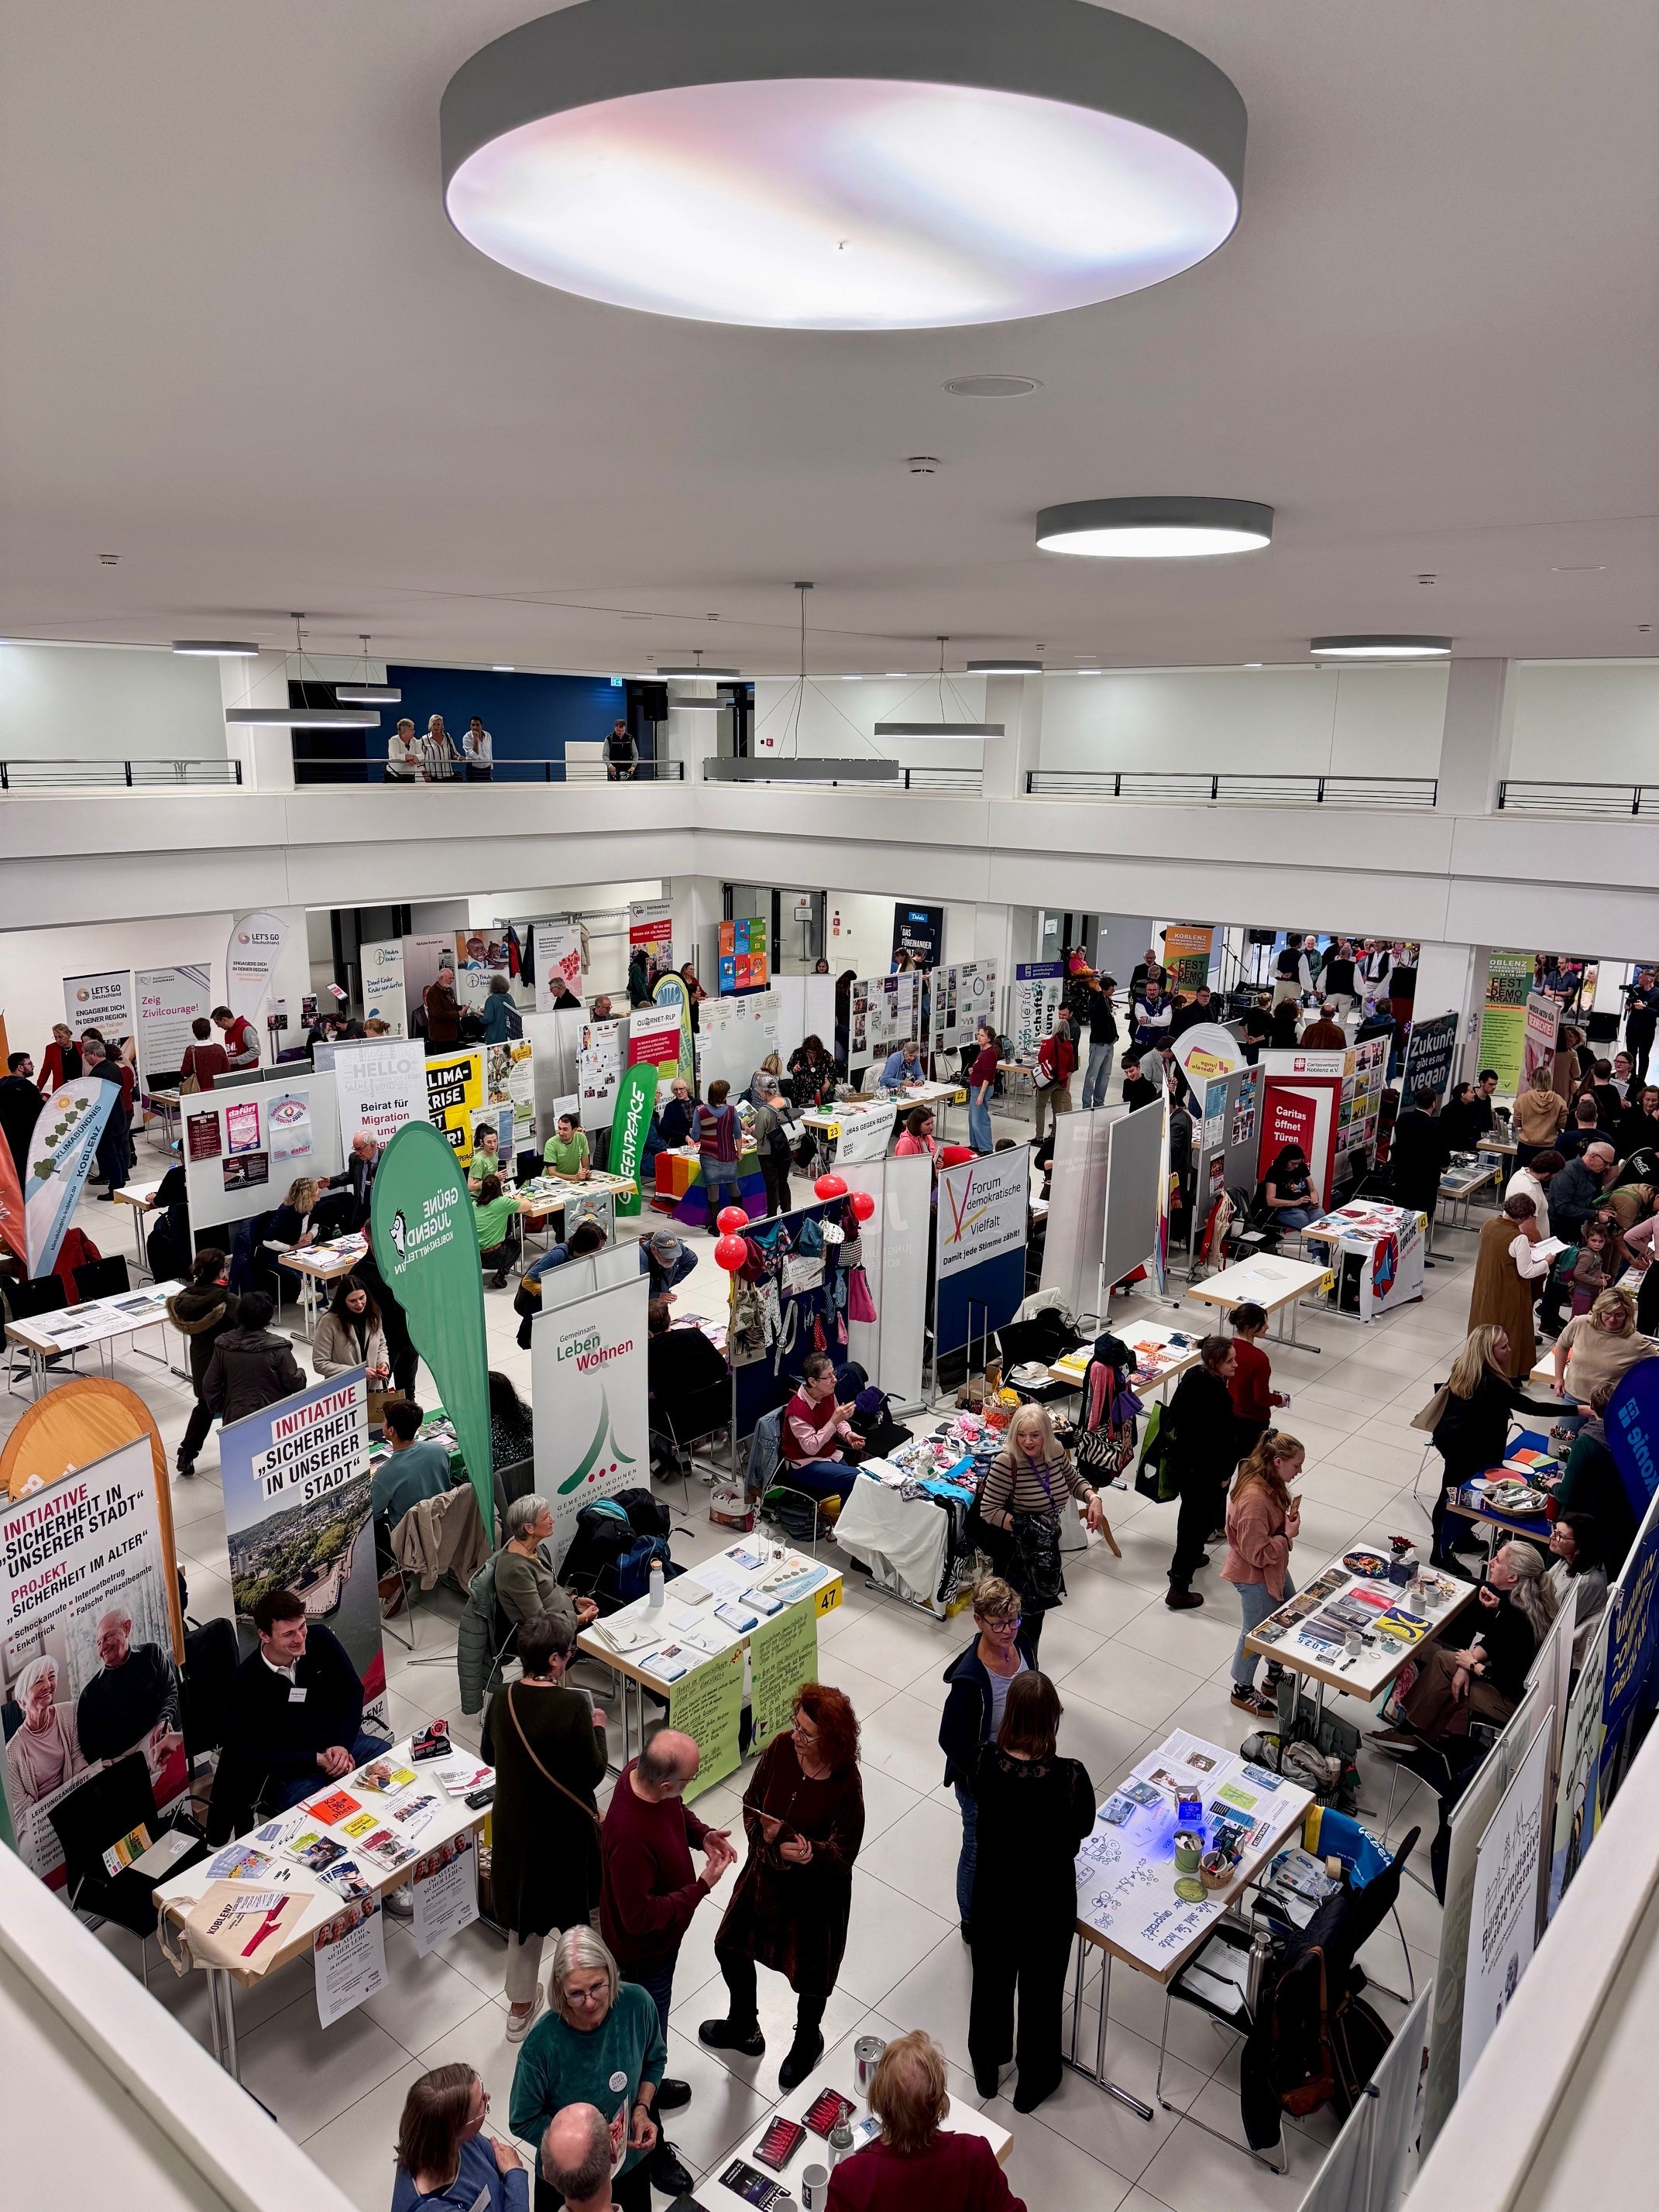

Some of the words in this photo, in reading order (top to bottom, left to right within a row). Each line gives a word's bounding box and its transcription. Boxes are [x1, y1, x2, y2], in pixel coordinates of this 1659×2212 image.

[902, 928, 911, 937] DAS
[902, 937, 932, 950] FÜREINANDER
[1179, 959, 1205, 970] FEST
[1489, 959, 1527, 967] OBLENZ
[1179, 970, 1204, 980] DEMO
[1492, 977, 1523, 988] FEST
[91, 985, 110, 994] LET'S
[92, 991, 122, 1000] Deutschland
[1491, 988, 1523, 998] DEMO
[141, 996, 161, 1005] Zeig
[1529, 1004, 1539, 1013] WERDE
[76, 1006, 110, 1017] ENGAGIERE
[110, 1004, 125, 1014] DICH
[83, 1016, 105, 1025] DEINER
[105, 1012, 127, 1022] REGION
[143, 1004, 198, 1018] Zivilcourage!
[1033, 984, 1042, 1038] schafts-
[1410, 1027, 1455, 1057] Zukunft
[353, 1060, 410, 1079] HELLO
[1417, 1058, 1428, 1071] gibt
[1428, 1056, 1435, 1064] es
[1435, 1053, 1445, 1063] nur
[427, 1067, 469, 1089] LIMA-
[1410, 1066, 1446, 1091] vegan
[228, 1105, 256, 1117] dafür!
[271, 1100, 307, 1117] Interkulturelle
[361, 1101, 392, 1112] Beirat
[394, 1099, 409, 1108] für
[1276, 1106, 1307, 1120] Caritas
[292, 1112, 304, 1121] 2025
[362, 1111, 410, 1125] Migration
[846, 1125, 860, 1135] OMAS
[860, 1120, 876, 1132] GEGEN
[876, 1112, 894, 1125] RECHTS
[1275, 1118, 1301, 1131] öffnet
[56, 1104, 102, 1160] KLIMABÜNDNIS
[377, 1125, 397, 1136] und
[830, 1128, 838, 1136] 23
[1274, 1132, 1298, 1143] Türen
[77, 1125, 102, 1177] KOBLENZ
[290, 1145, 310, 1155] dafür!
[617, 1082, 644, 1205] GEENPEACE
[972, 1177, 1001, 1195] Forum
[967, 1183, 1021, 1210] demokratische
[970, 1216, 1001, 1235] Vielfalt
[1420, 1218, 1426, 1228] 43
[1400, 1222, 1417, 1252] EUROPE
[943, 1252, 962, 1266] Damit
[963, 1245, 977, 1259] jede
[979, 1238, 1001, 1252] Stimme
[1003, 1229, 1020, 1241] zählt!
[1324, 1275, 1331, 1286] 44
[559, 1325, 596, 1342] Gemeinsam
[558, 1335, 600, 1362] Leben
[576, 1340, 634, 1372] Wohnen
[276, 1386, 356, 1439] INITIATIVE
[258, 1410, 358, 1477] „SICHERHEIT
[266, 1472, 283, 1495] IN
[290, 1434, 359, 1483] UNSERER
[304, 1456, 360, 1500] STADT“
[558, 1485, 602, 1510] GEMEINSAM
[606, 1468, 637, 1486] WOHNEN
[578, 1496, 598, 1509] Region
[600, 1483, 623, 1496] Koblenz
[4, 1483, 88, 1542] INITIATIVE
[0, 1495, 100, 1567] „SICHERHEIT
[107, 1484, 122, 1506] IN
[8, 1525, 84, 1578] UNSERER
[90, 1490, 144, 1534] STADT“
[7, 1565, 86, 1625] „SICHERHEIT
[91, 1555, 105, 1573] IM
[108, 1529, 148, 1562] ALTER“
[12, 1561, 67, 1603] PROJEKT
[75, 1568, 125, 1603] Internetbetrug
[778, 1574, 816, 1588] KLIMABÜNDNIS
[77, 1595, 103, 1617] Falsche
[105, 1565, 153, 1598] Polizeibeamte
[789, 1581, 813, 1598] KOBLENZ
[821, 1589, 836, 1609] 47
[14, 1602, 67, 1640] Schockanrufe
[16, 1623, 56, 1652] Enkeltrick
[1296, 1636, 1328, 1653] 2025
[438, 1864, 458, 1878] ALLTAG
[424, 1879, 444, 1894] SICHER
[445, 1867, 463, 1880] LEBEN
[1482, 1824, 1540, 1953] Bürgerinitiative
[1196, 1901, 1217, 1913] Wie
[207, 1904, 232, 1935] KOBLENZ
[1142, 1910, 1173, 1941] angereist?
[1183, 1911, 1200, 1928] sind
[1174, 1924, 1192, 1934] Sie
[327, 1944, 350, 1962] SICHER
[350, 1931, 370, 1945] LEBEN
[332, 1942, 342, 1952] IM
[344, 1927, 365, 1942] ALLTAG
[1159, 1932, 1183, 1949] heute
[612, 2073, 622, 2083] OMAS
